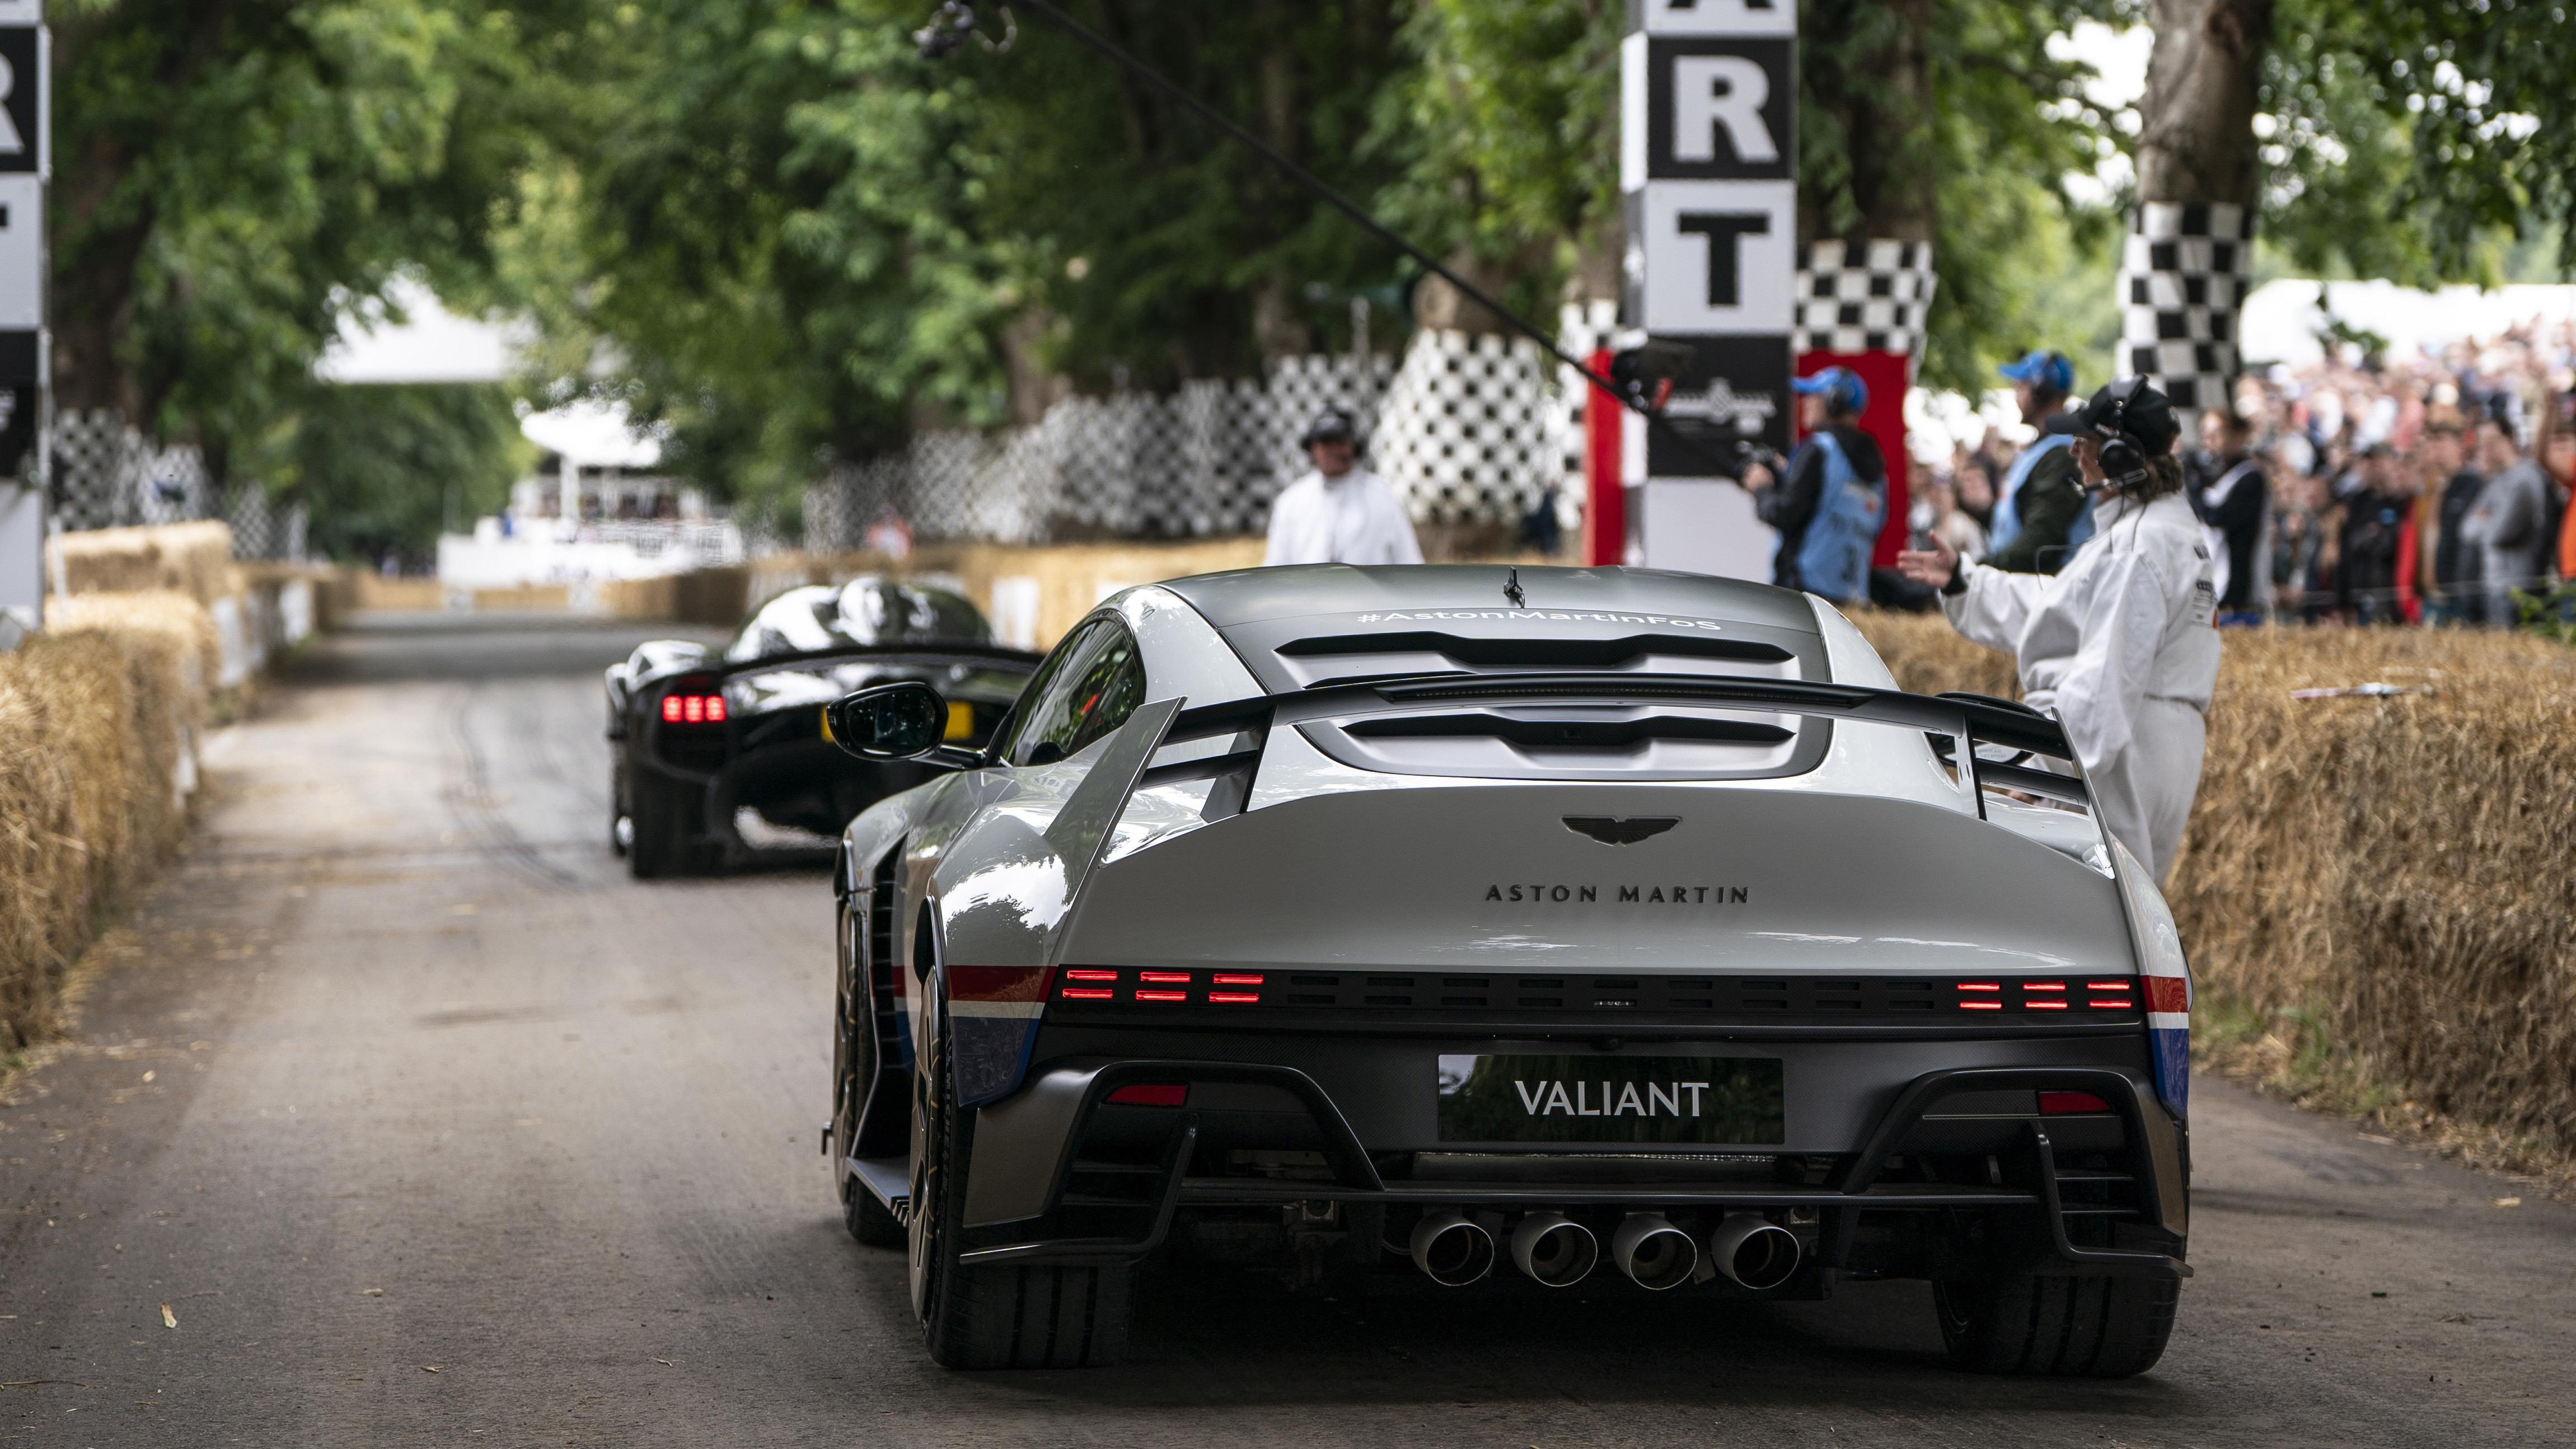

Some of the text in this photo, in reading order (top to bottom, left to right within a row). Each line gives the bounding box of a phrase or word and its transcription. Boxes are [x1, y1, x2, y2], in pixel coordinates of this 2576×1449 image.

[1668, 0, 1779, 306] RT
[1357, 611, 1722, 630] #AstonMartinFoS
[1485, 884, 1749, 903] ASTON MARTIN
[1515, 1081, 1709, 1117] VALIANT
